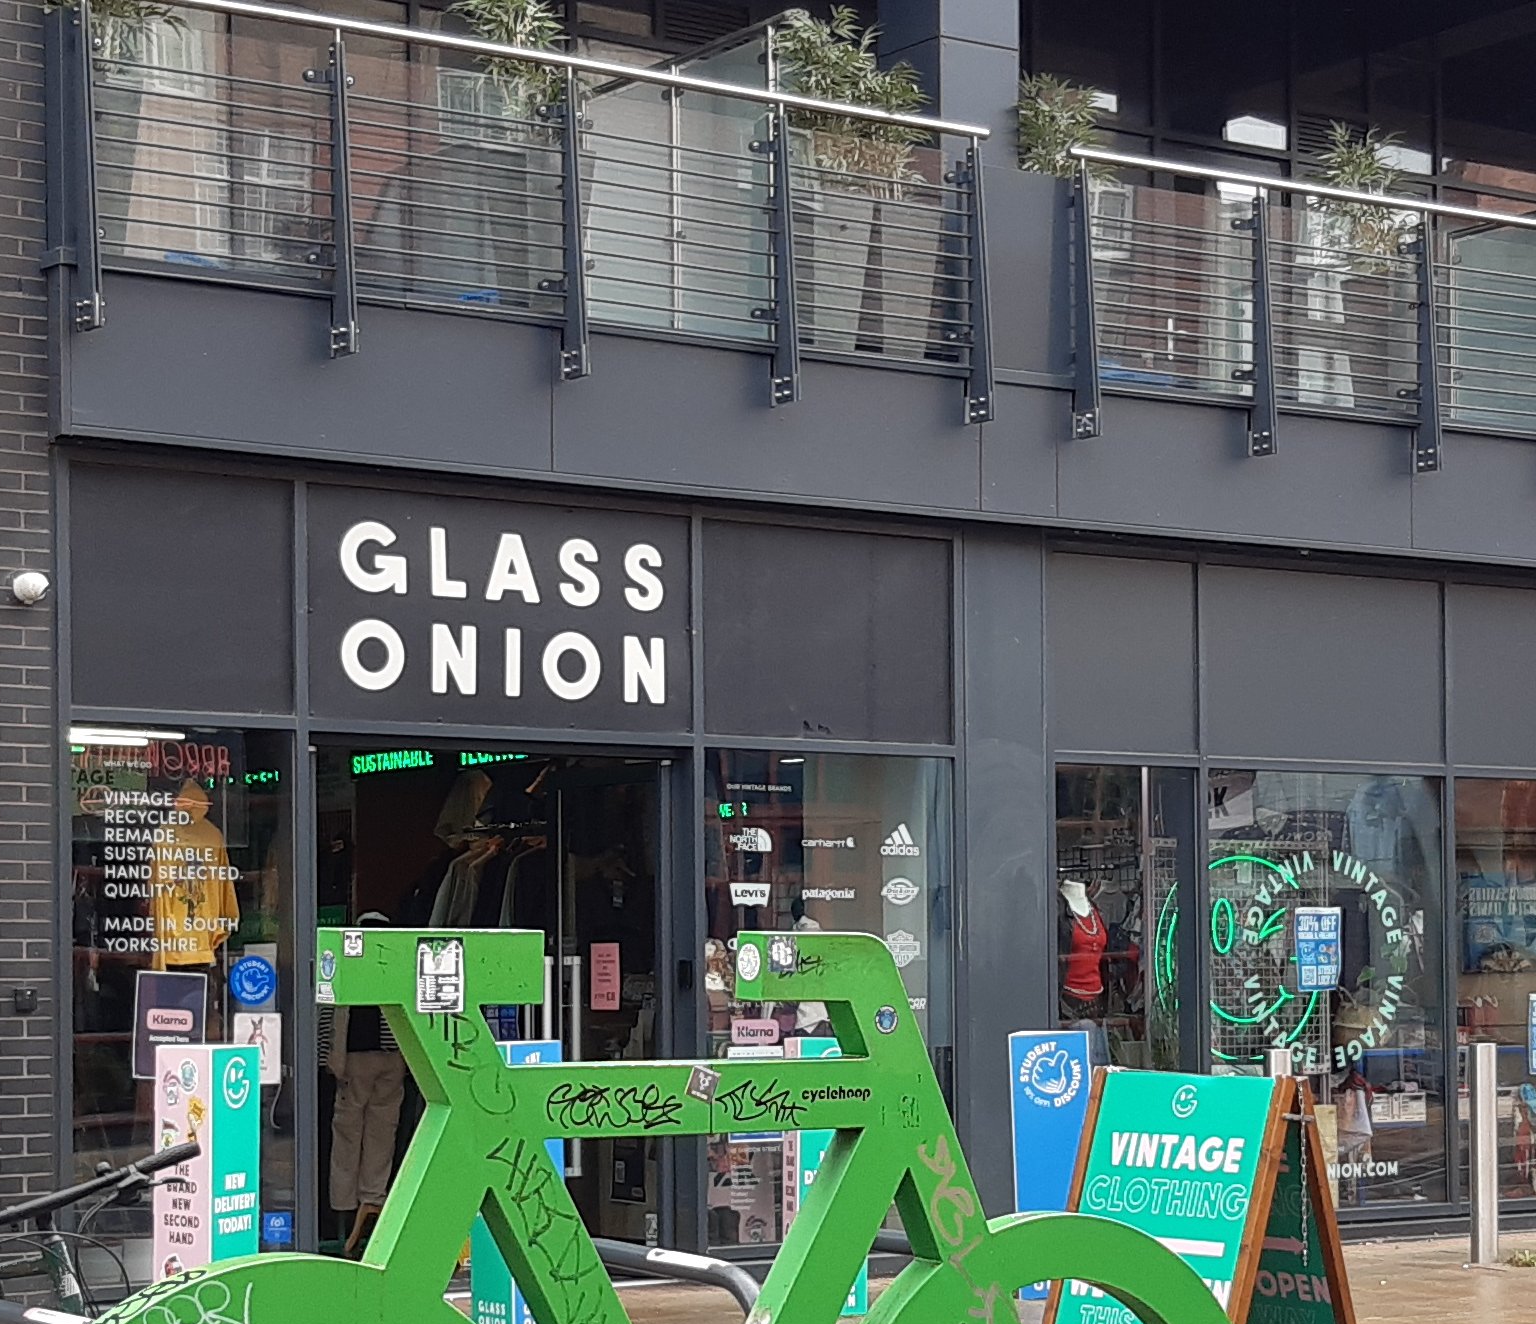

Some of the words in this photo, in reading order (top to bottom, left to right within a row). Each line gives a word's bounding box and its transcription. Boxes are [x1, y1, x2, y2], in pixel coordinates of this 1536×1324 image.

[340, 521, 664, 611] GLASS
[341, 619, 664, 704] ONION
[353, 750, 434, 774] SUSTAINABLE
[71, 769, 114, 785] TAGE
[105, 810, 194, 825] RECYCLED.
[105, 829, 180, 843] REMADE.
[729, 835, 758, 843] NORTH
[742, 828, 757, 836] THE
[105, 847, 218, 862] SUSTAINABLE.
[880, 845, 920, 857] adidas
[105, 866, 152, 880] HAND
[158, 866, 244, 881] SELECTED.
[802, 888, 856, 900] patagonia
[1333, 850, 1403, 943] VINTAGE
[105, 917, 155, 932] MADE
[161, 917, 176, 931] IN
[183, 917, 239, 932] SOUTH
[152, 1014, 188, 1026] Klarna
[1244, 974, 1317, 1068] VINTAGE
[1335, 976, 1403, 1068] VINTAGE
[737, 1026, 773, 1037] Klarna
[1020, 1042, 1057, 1082] STUDENT
[1054, 1059, 1081, 1107] DISCOUNT
[802, 1087, 870, 1101] cyclehoop
[1111, 1132, 1245, 1174] VINTAGE
[1327, 1161, 1399, 1179] NION.COM
[224, 1172, 246, 1191] NEW
[172, 1198, 191, 1210] NEW
[214, 1192, 256, 1213] DELIVERY
[1086, 1175, 1248, 1221] CLOTHING
[164, 1214, 200, 1228] SECOND
[218, 1214, 252, 1234] TODAY!
[169, 1231, 194, 1245] HAND
[1257, 1270, 1331, 1304] OPEN
[478, 1300, 506, 1315] GLASS
